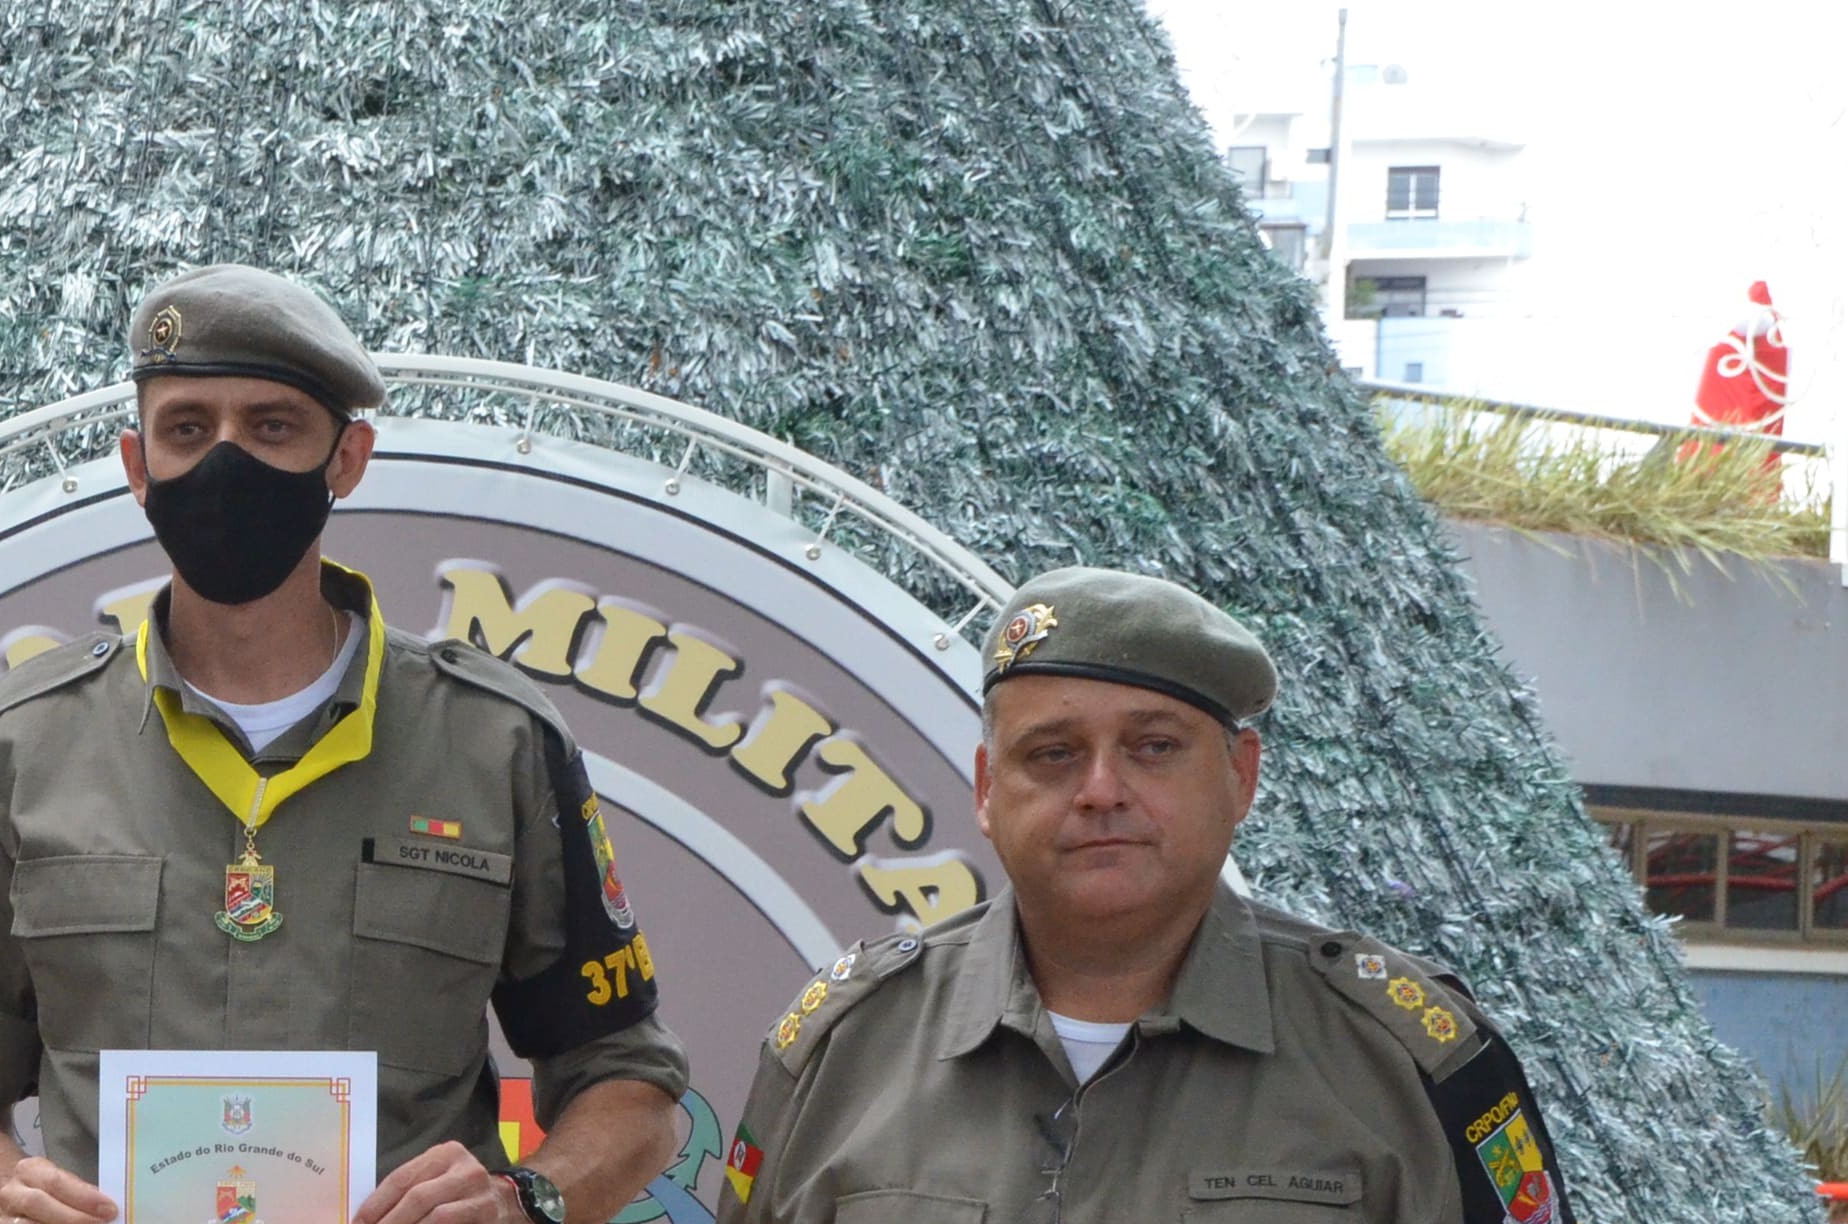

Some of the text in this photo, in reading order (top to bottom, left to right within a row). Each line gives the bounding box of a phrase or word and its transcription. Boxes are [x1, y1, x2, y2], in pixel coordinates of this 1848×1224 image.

[436, 560, 984, 931] MILITA
[399, 846, 490, 871] SGT NICOLA
[149, 1143, 326, 1176] Estado do Rio Grande do Sul
[1204, 1175, 1344, 1193] TEN CEL AGUIAR
